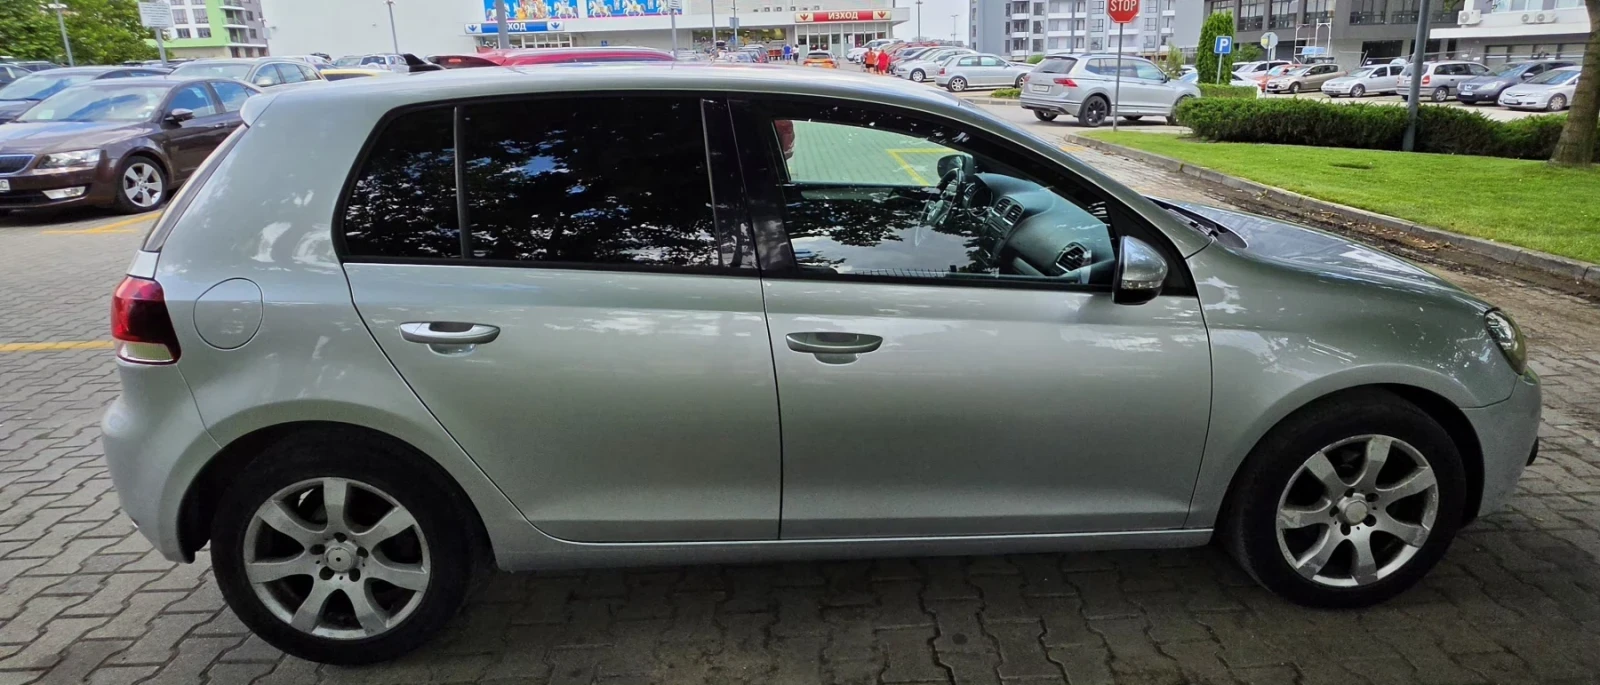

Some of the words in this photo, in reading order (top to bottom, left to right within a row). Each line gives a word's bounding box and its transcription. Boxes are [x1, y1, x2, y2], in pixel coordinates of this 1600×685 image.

[1110, 0, 1137, 11] STOP
[828, 11, 859, 20] ИЗХОД
[506, 22, 527, 32] ХОД
[1219, 38, 1229, 51] P
